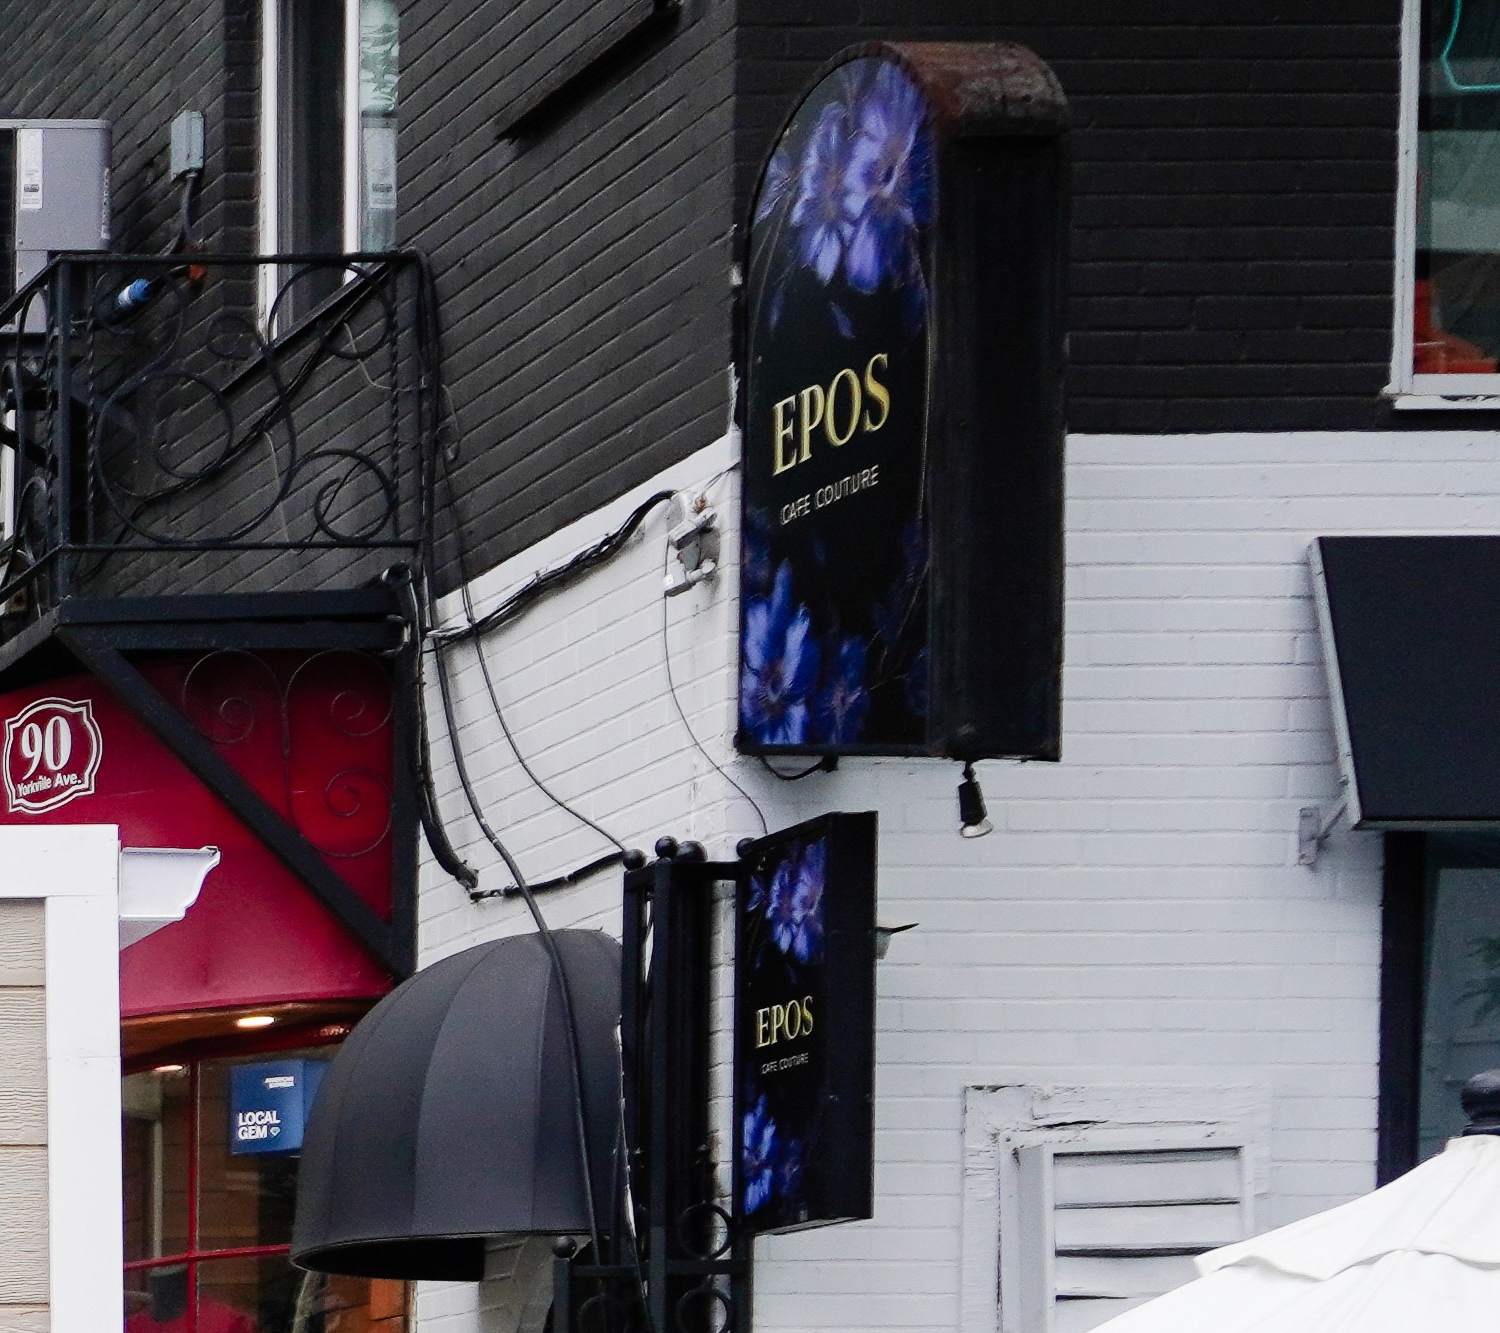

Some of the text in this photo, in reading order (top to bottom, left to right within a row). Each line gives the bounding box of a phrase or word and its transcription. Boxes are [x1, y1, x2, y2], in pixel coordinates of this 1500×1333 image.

[773, 353, 890, 476] EPOS
[781, 464, 879, 526] CAFE COUTURE
[21, 716, 72, 780] 90
[17, 773, 82, 797] Yorkville Ave.
[756, 995, 813, 1048] EPOS
[238, 1111, 281, 1126] LOCAL
[238, 1126, 267, 1140] GEM
